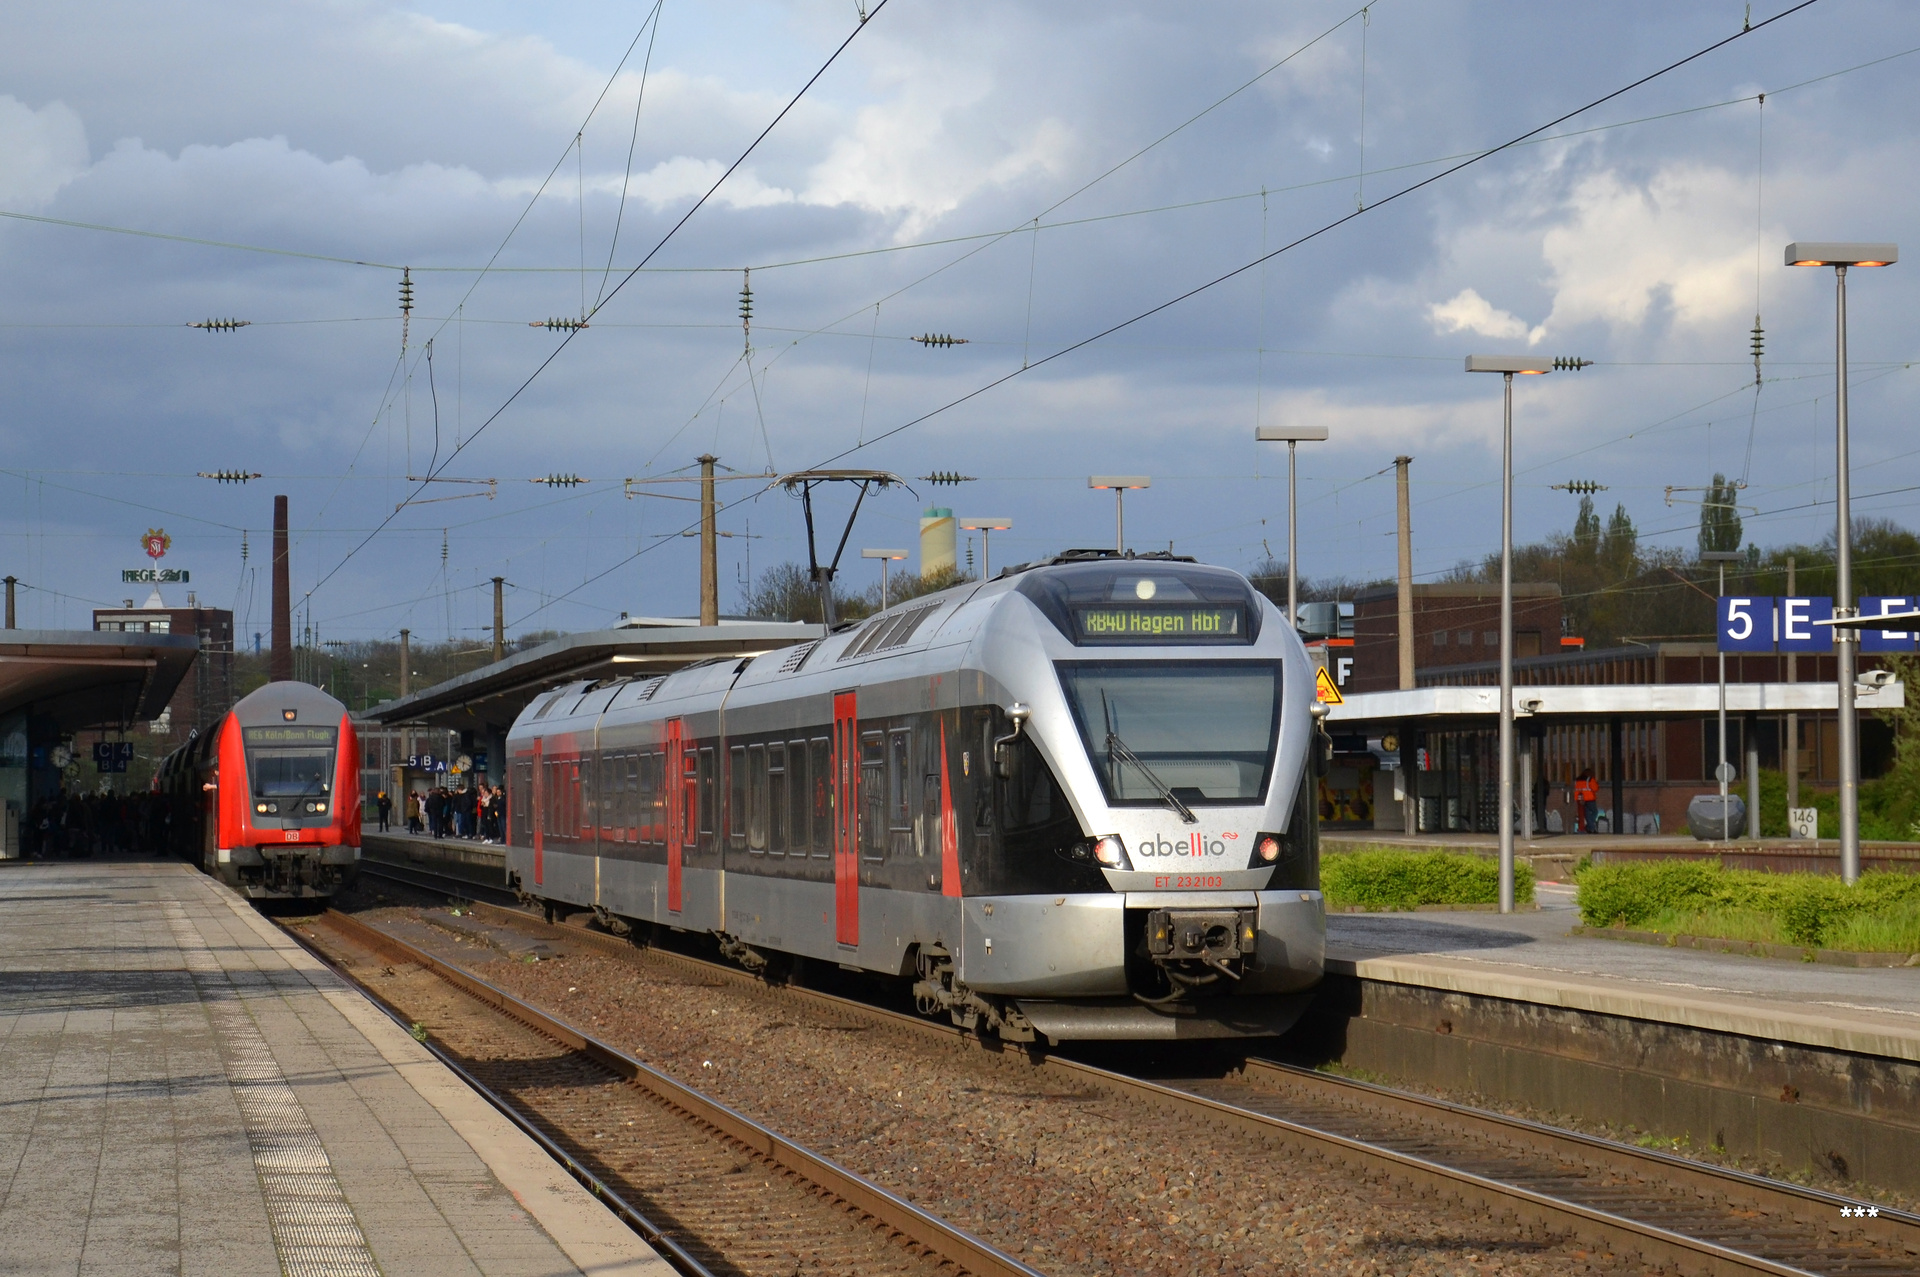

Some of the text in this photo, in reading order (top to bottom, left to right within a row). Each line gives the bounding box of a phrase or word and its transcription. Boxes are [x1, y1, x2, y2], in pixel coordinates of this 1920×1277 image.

[1086, 611, 1221, 633] RB40 Hagen Hbf
[1727, 599, 1753, 640] 5
[1785, 599, 1811, 639] E
[1337, 657, 1354, 686] F
[99, 743, 131, 757] C 4
[102, 760, 125, 770] B 4
[409, 755, 432, 766] 5 B
[436, 761, 444, 771] A
[1793, 810, 1814, 823] 146
[1800, 824, 1809, 836] 0
[286, 833, 299, 841] DB
[1139, 832, 1225, 857] abellio
[1155, 876, 1170, 888] ET
